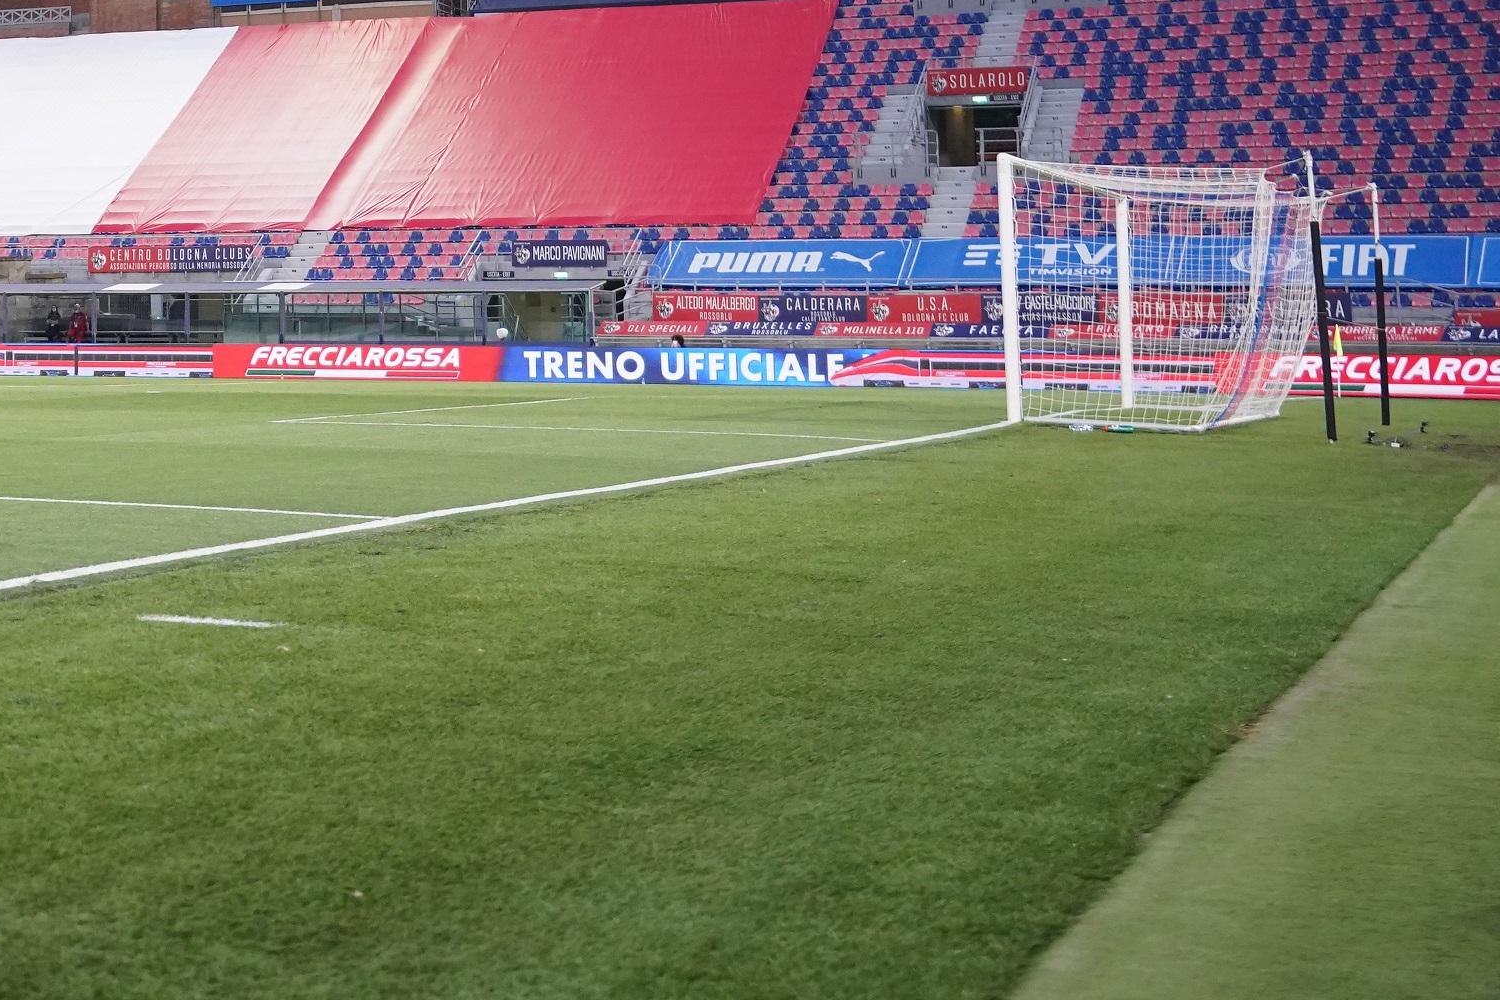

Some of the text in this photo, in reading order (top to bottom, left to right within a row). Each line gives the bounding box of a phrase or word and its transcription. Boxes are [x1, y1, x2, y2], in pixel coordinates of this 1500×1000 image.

[949, 71, 1025, 89] SOLAROLO
[110, 247, 251, 261] CENTRO BOLOGNA CLUBS
[532, 245, 605, 261] MARCO PAVIGNANI
[1320, 244, 1416, 276] FIAT
[110, 262, 147, 270] ASSOCIAZIONE
[149, 262, 178, 270] PERCORSO
[179, 262, 195, 270] DELLA
[196, 261, 221, 269] MEMORIA
[687, 251, 823, 274] PUMA
[1030, 268, 1112, 276] TIMVISION
[676, 296, 756, 311] ALTEDO MALALBERGO
[786, 297, 861, 311] CALDERARA
[917, 297, 952, 311] U.S.A.
[1025, 295, 1096, 310] CASTELMAGGIORE
[1131, 300, 1217, 319] ROMAGNA
[700, 311, 733, 321] ROSSOBLU
[902, 312, 969, 322] BOLOGNA FC CLUB
[627, 324, 699, 333] GLI SPECIALI
[734, 322, 813, 330] BRUXELLES
[843, 327, 924, 335] MOLINELLA 110
[969, 325, 1033, 335] FAEA
[1339, 326, 1439, 335] PORRETA TERME
[250, 347, 460, 368] FRECCIAROSSA
[523, 351, 844, 382] TRENO UFFICIALE
